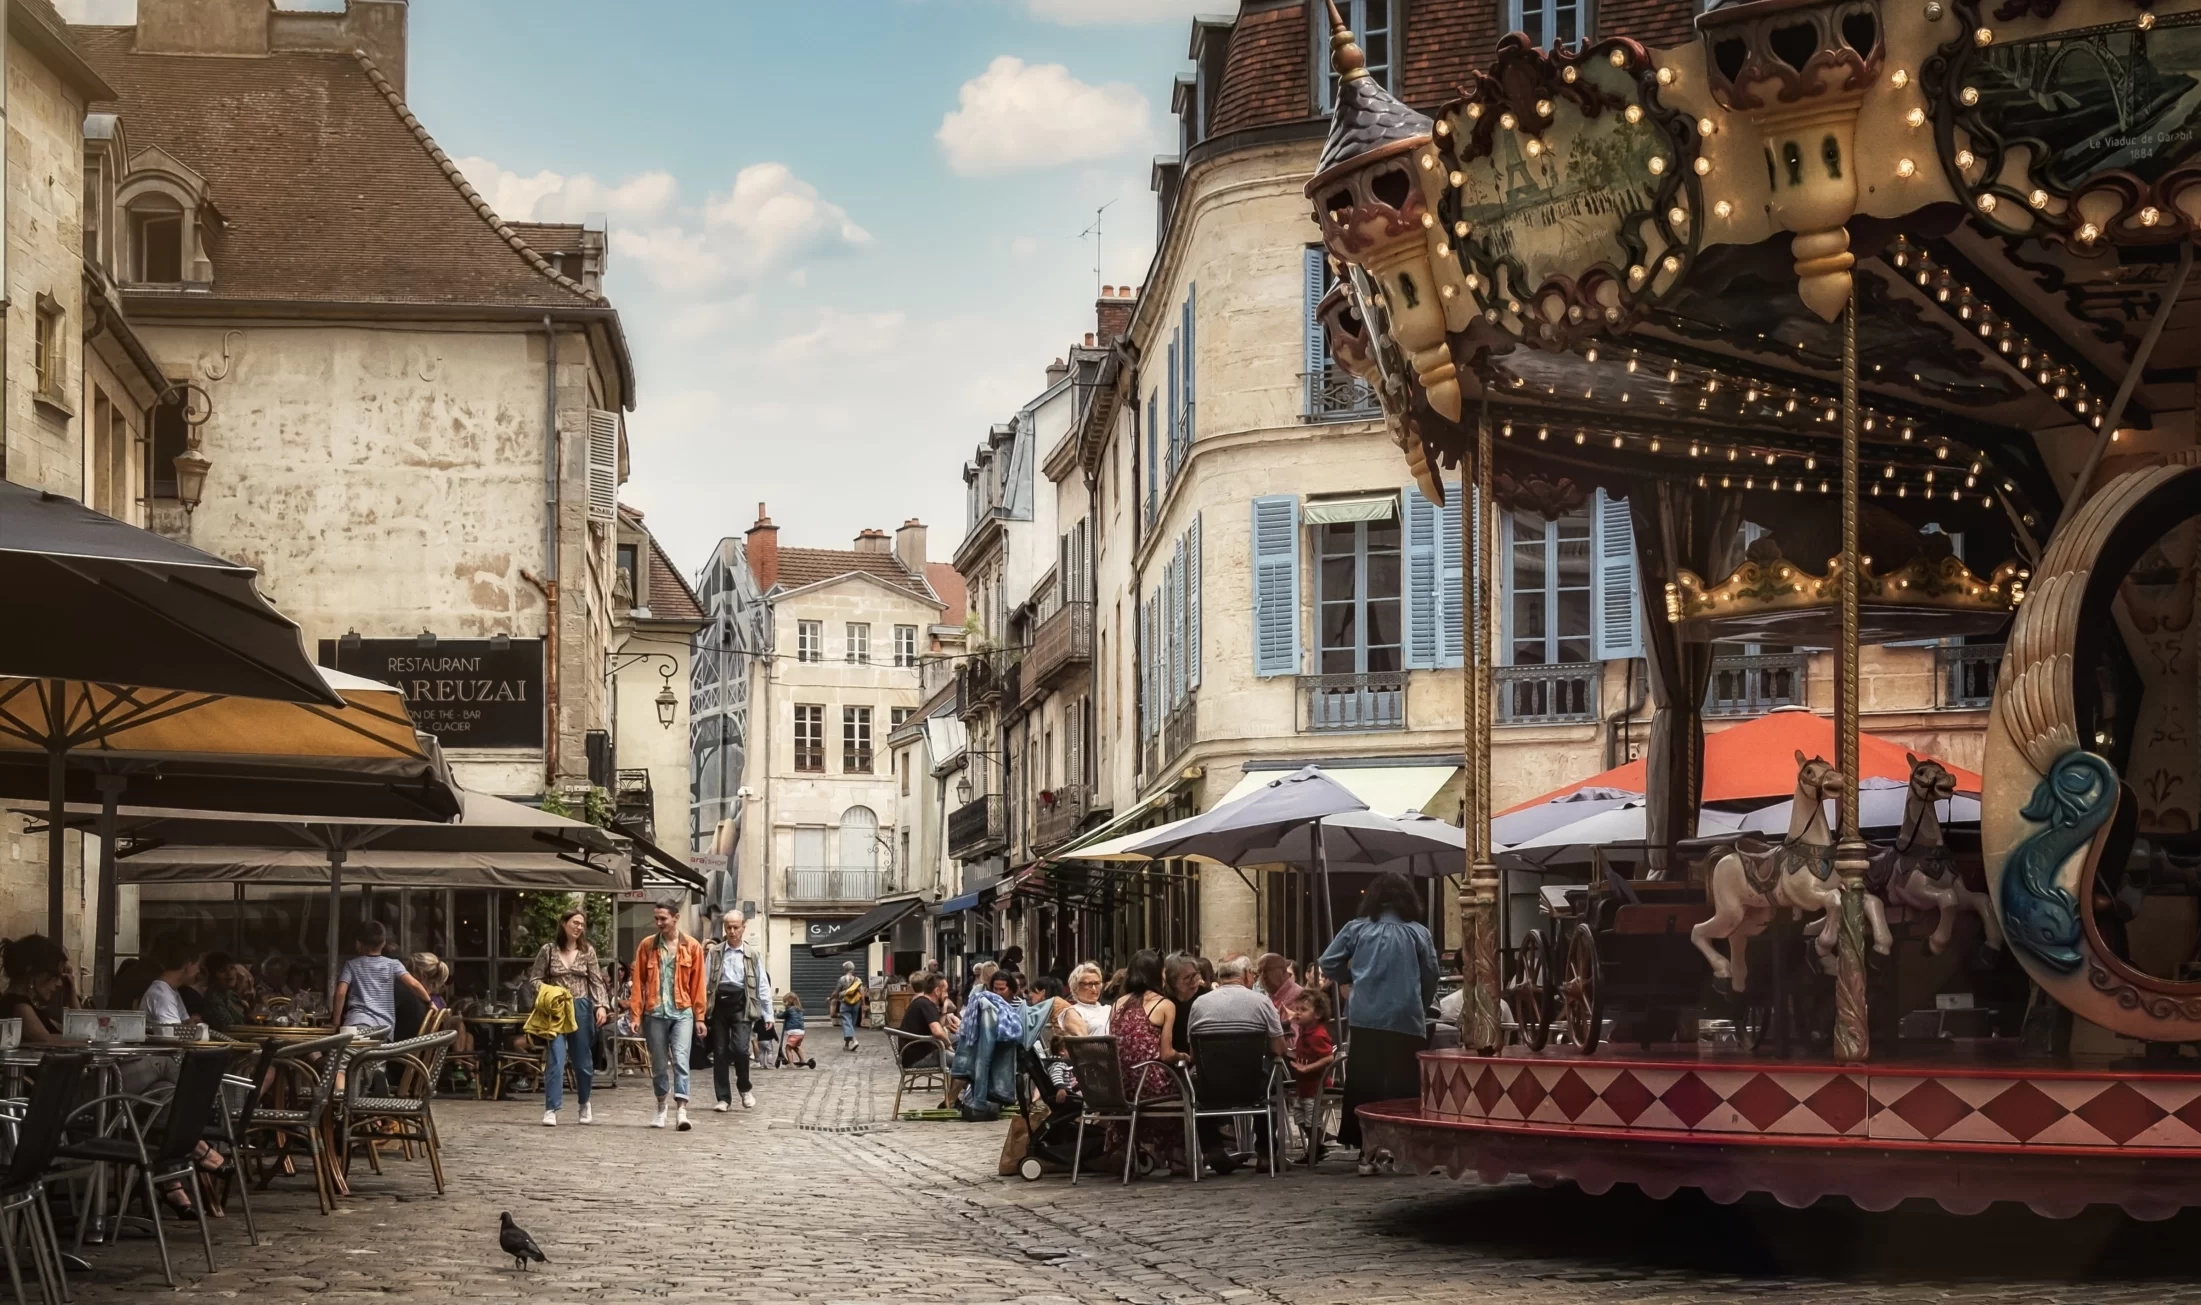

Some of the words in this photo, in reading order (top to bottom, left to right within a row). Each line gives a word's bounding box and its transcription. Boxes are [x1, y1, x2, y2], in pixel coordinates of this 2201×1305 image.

[2089, 139, 2101, 149] Le
[2104, 135, 2137, 147] Viaduc
[2141, 134, 2153, 144] de
[2130, 148, 2153, 159] 1884
[388, 657, 482, 672] RESTAURANT
[423, 709, 436, 720] DE
[439, 708, 454, 720] THÉ
[463, 709, 481, 720] BAR
[432, 721, 471, 731] GLACIER
